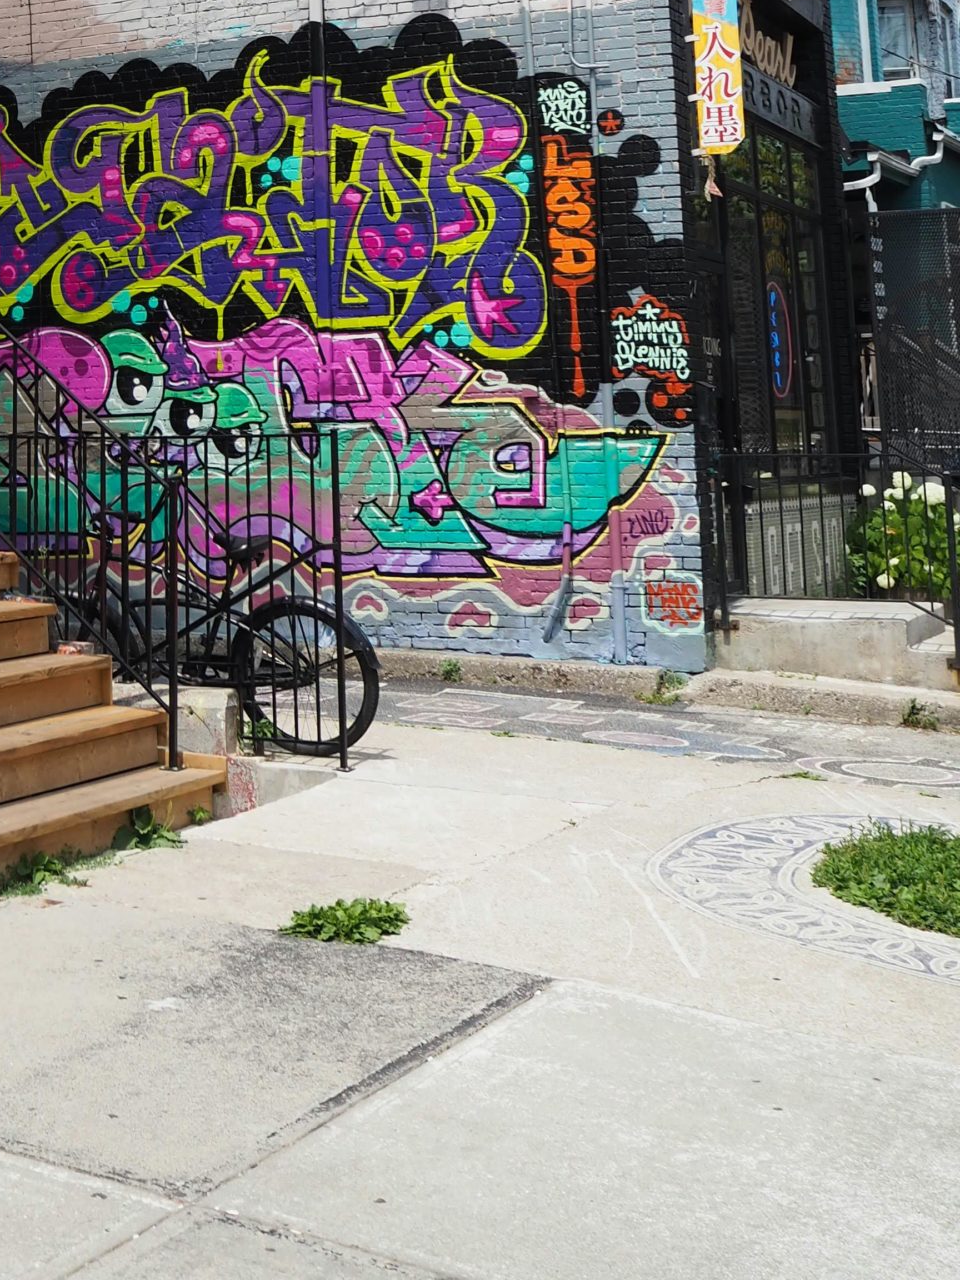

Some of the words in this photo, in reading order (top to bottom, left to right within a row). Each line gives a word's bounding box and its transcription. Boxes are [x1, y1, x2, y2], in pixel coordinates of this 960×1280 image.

[700, 23, 740, 144] 入れ墨
[743, 70, 803, 131] RBOR
